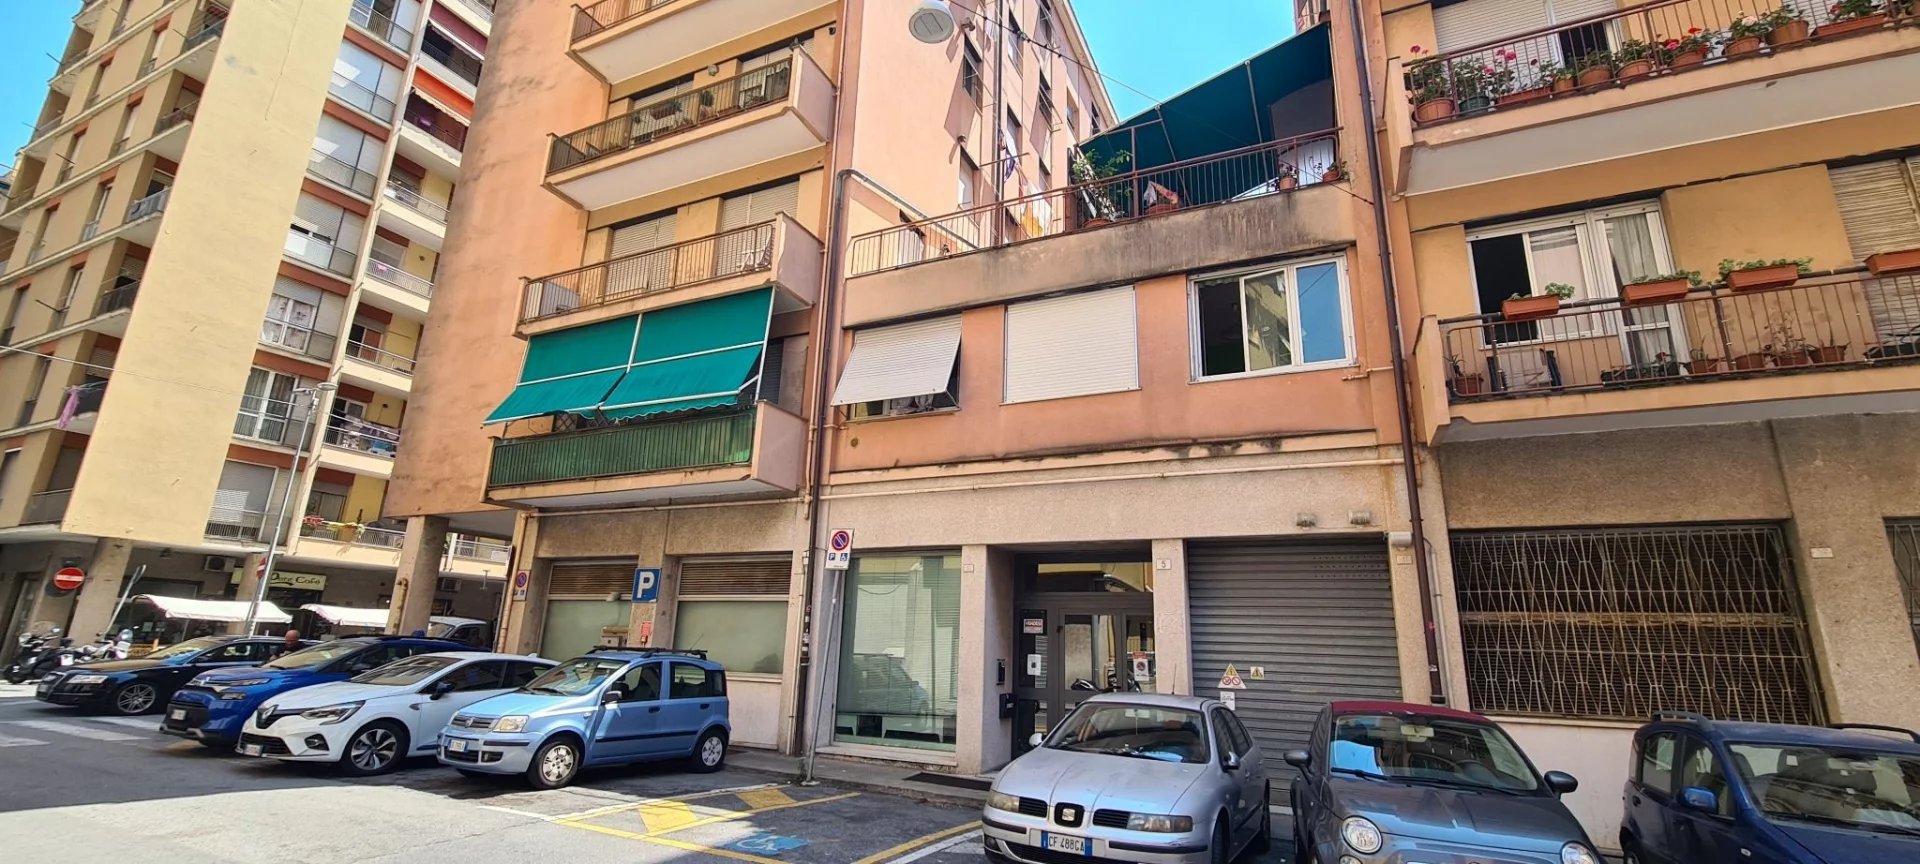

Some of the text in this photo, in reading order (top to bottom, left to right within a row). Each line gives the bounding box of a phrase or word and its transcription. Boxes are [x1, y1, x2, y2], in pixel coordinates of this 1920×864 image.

[1161, 560, 1167, 568] 5
[637, 571, 655, 599] P
[1048, 836, 1058, 847] CF
